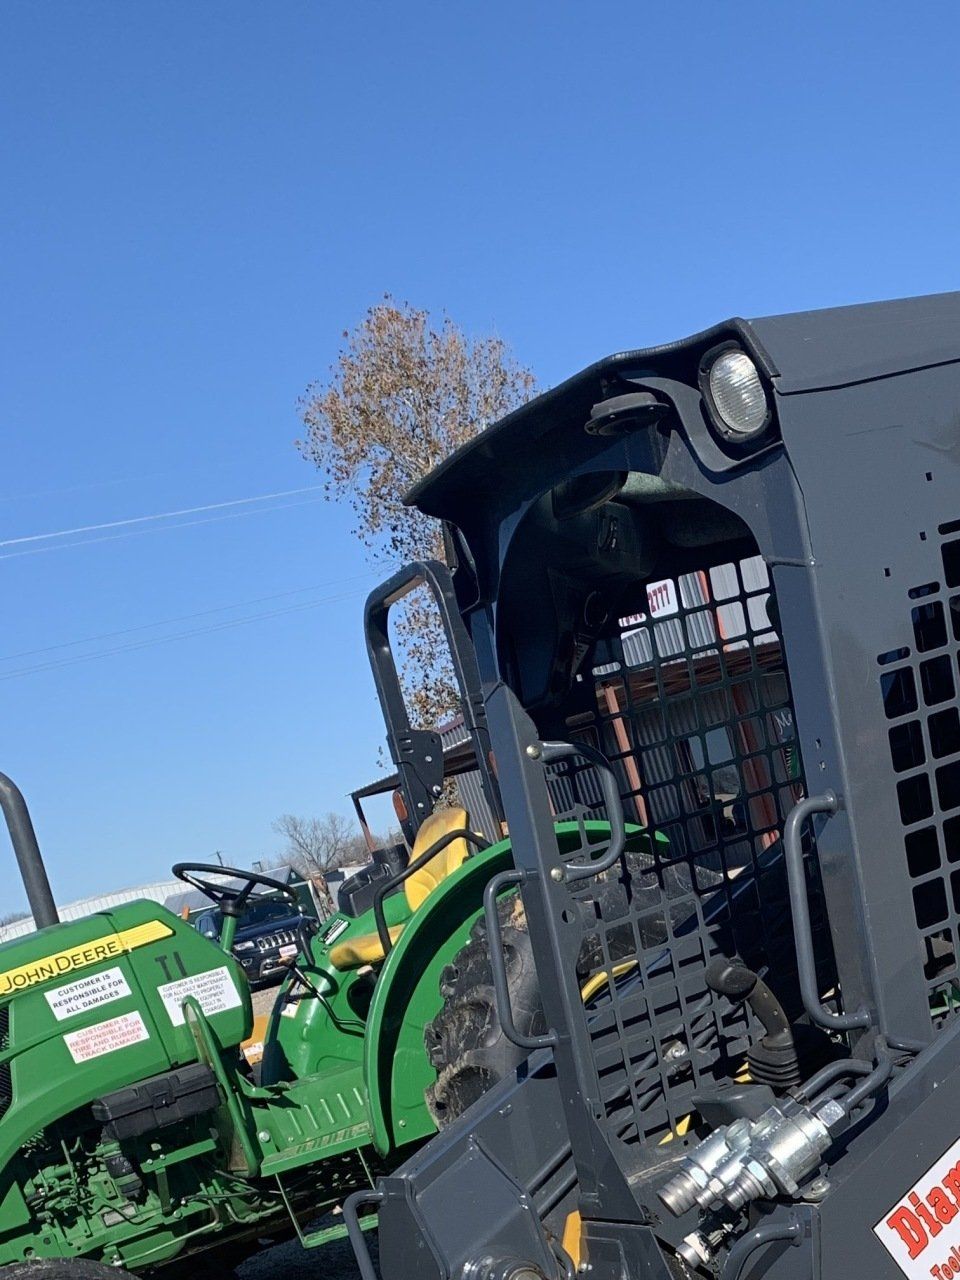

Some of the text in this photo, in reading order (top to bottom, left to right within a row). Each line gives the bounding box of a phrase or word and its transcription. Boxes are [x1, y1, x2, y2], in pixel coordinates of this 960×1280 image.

[4, 941, 119, 992] JOHN DEERE
[52, 978, 124, 1009] RESPONSIBLE FOR
[58, 977, 101, 997] CUSTOMER
[66, 990, 120, 1014] ALL DAMAGES
[69, 1020, 141, 1049] RESPONSIBLE FOR
[74, 1027, 143, 1054] TIRE AND RUBBER
[76, 1018, 119, 1039] CUSTOMER
[80, 1034, 141, 1059] TRACK DAMAGE
